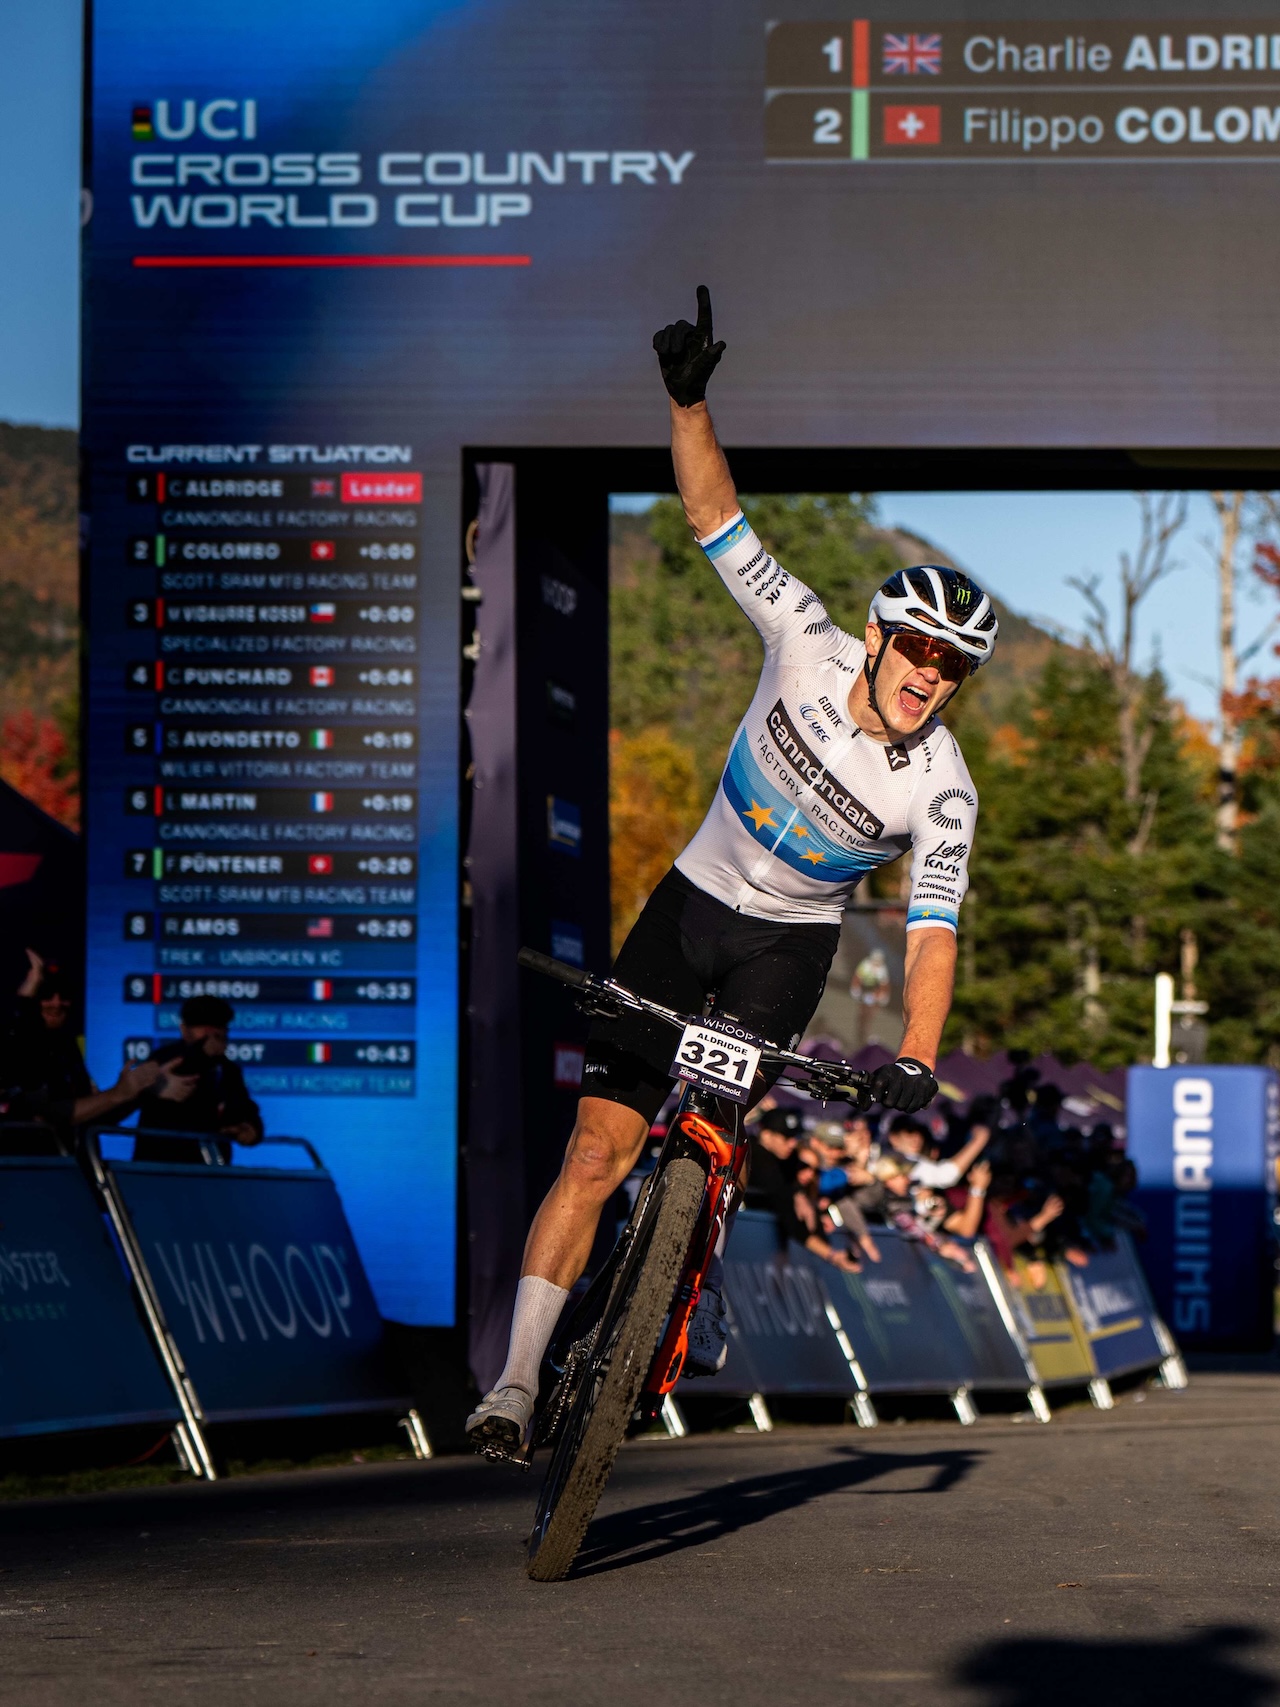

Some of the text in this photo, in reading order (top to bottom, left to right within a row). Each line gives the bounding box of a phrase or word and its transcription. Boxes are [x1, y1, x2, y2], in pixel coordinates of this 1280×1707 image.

[823, 35, 843, 73] 1
[964, 35, 1111, 72] Charlie
[154, 99, 257, 140] UCI
[813, 108, 842, 144] 2
[963, 107, 1104, 151] Filippo
[131, 151, 695, 186] CROSS COUNTRY
[131, 193, 531, 227] WORLD CUP
[127, 444, 411, 463] CURRENT SITUATION
[137, 480, 148, 497] 1
[186, 480, 283, 497] ALDRIDGE
[350, 482, 414, 497] Leader
[162, 511, 417, 528] CANNONDALE FACTORY RACING
[134, 542, 149, 559] 2
[183, 542, 280, 560] COLOMBO
[360, 543, 415, 561] +0:00
[308, 573, 368, 590] RACING
[373, 574, 417, 590] TEAM
[134, 605, 148, 622] 3
[359, 606, 415, 623] +0:00
[162, 636, 416, 652] SPECIALIZED FACTORY RACING
[133, 667, 148, 684] 4
[184, 667, 292, 685] PUNCHARD
[160, 699, 415, 716] CANNONDALE FACTORY RACING
[818, 696, 843, 728] GOBIK
[133, 729, 147, 747] 5
[183, 730, 300, 748] AVONDETTO
[811, 721, 831, 743] UEC
[294, 761, 366, 778] FACTORY
[370, 761, 415, 778] TEAM
[770, 710, 877, 836] cannondale
[757, 734, 865, 847] FACTORY RACING
[132, 791, 147, 809] 6
[181, 793, 256, 810] MARTIN
[159, 824, 414, 841] CANNONDALE FACTORY RACING
[926, 840, 968, 862] Lefty
[132, 854, 146, 872] 7
[180, 852, 282, 873] PÜNTENER
[305, 886, 365, 903] RACING
[370, 887, 414, 903] TEAM
[917, 882, 956, 895] SCHWALBE
[913, 893, 957, 904] SHIMANO
[131, 917, 145, 935] 8
[182, 918, 240, 935] AMOS
[357, 920, 412, 937] +0:20
[159, 950, 205, 966] TREK
[220, 951, 316, 967] UNBROKEN
[131, 980, 145, 997] 9
[179, 980, 259, 998] SARROU
[357, 982, 412, 999] +0:33
[282, 1013, 348, 1029] RACING
[703, 1018, 754, 1041] WHOOP
[126, 1042, 150, 1060] 10
[697, 1033, 748, 1056] ALDRIDGE
[681, 1041, 749, 1082] 321
[293, 1075, 364, 1092] FACTORY
[701, 1078, 741, 1097] Lake Placid
[1173, 1078, 1213, 1332] SHIMANO
[154, 1243, 351, 1343] WHOOP
